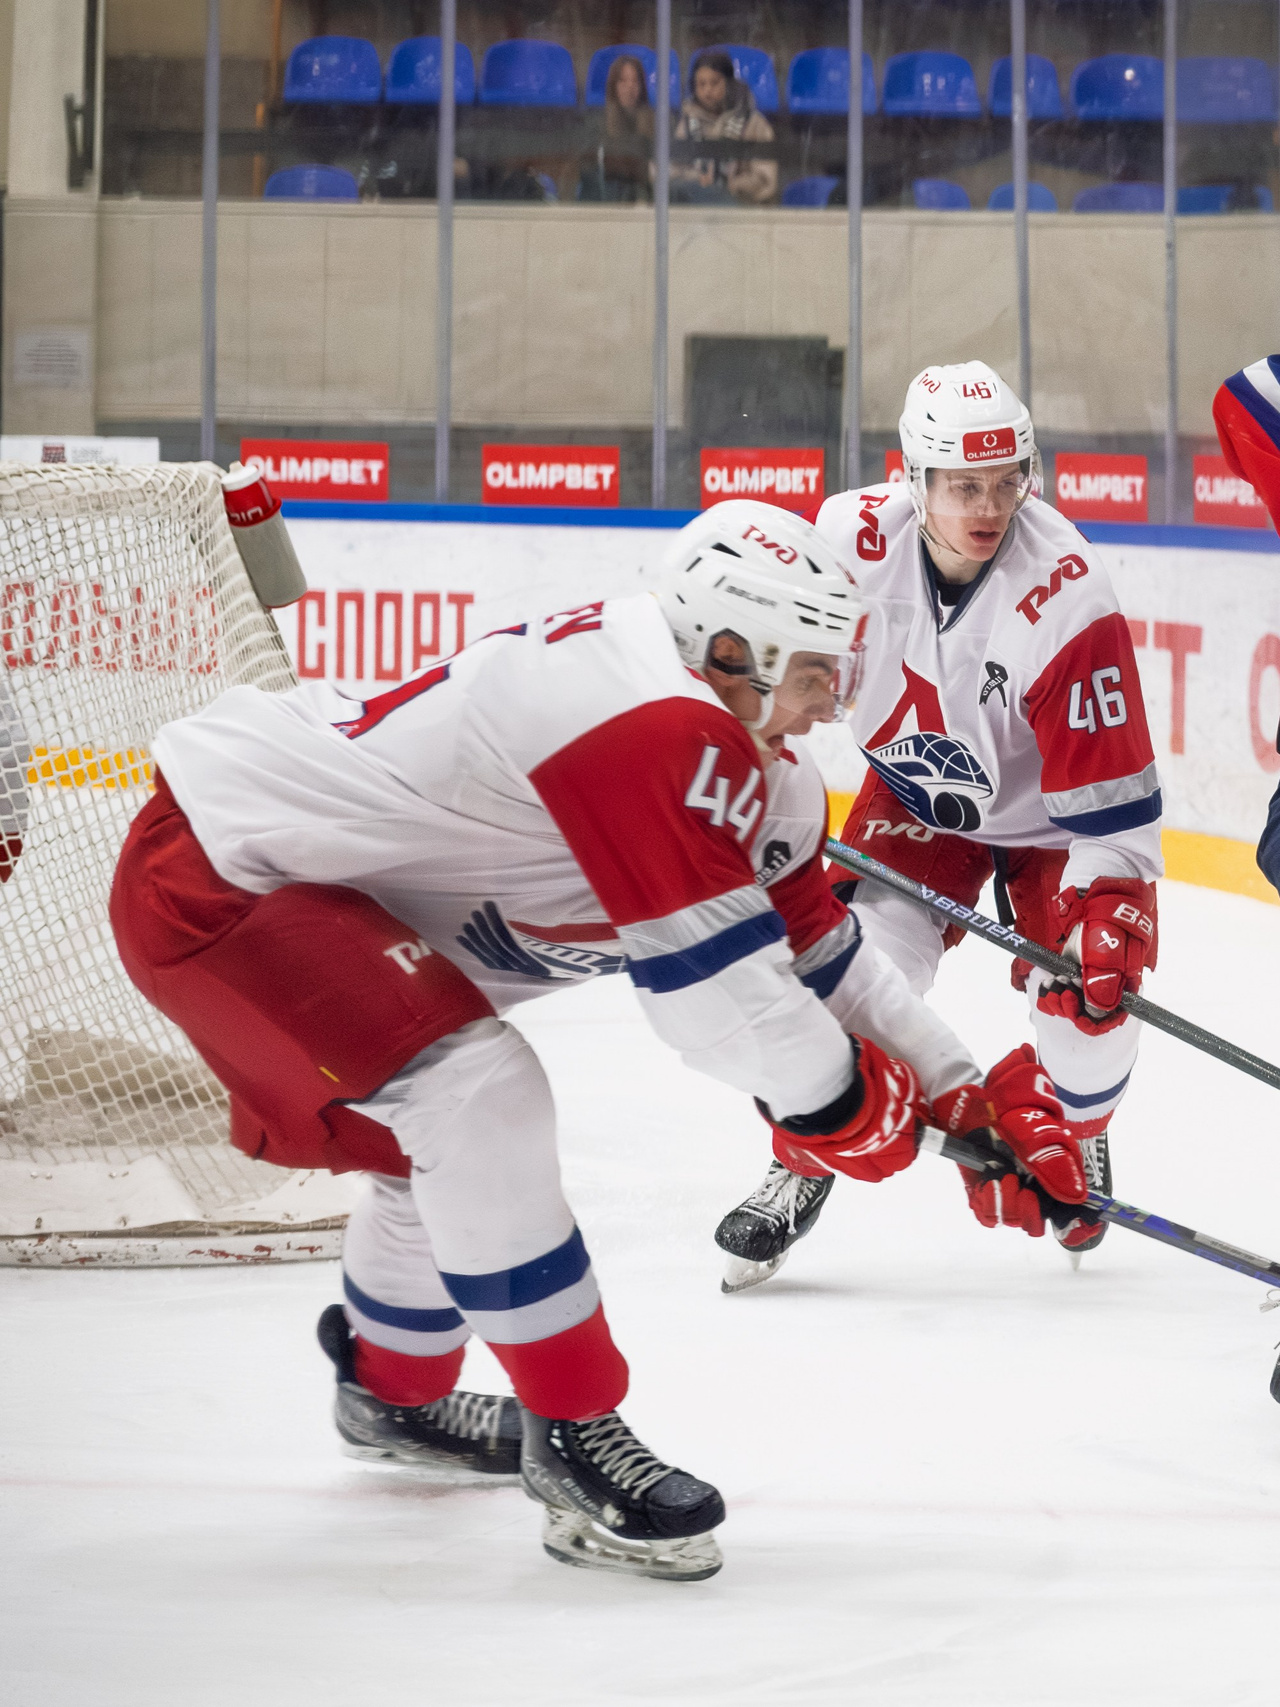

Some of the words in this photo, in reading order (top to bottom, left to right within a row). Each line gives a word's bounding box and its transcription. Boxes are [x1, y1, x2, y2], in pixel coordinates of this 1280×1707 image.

[962, 381, 993, 399] 46
[966, 447, 1014, 460] OLIMPBET
[485, 461, 616, 491] OLIMPBET
[703, 465, 820, 495] OLIMPBET
[1057, 472, 1144, 503] OLIMPBET
[299, 588, 475, 683] СПОРТ
[1068, 665, 1128, 734] 46
[684, 744, 764, 844] 44
[933, 893, 1026, 949] BAUER
